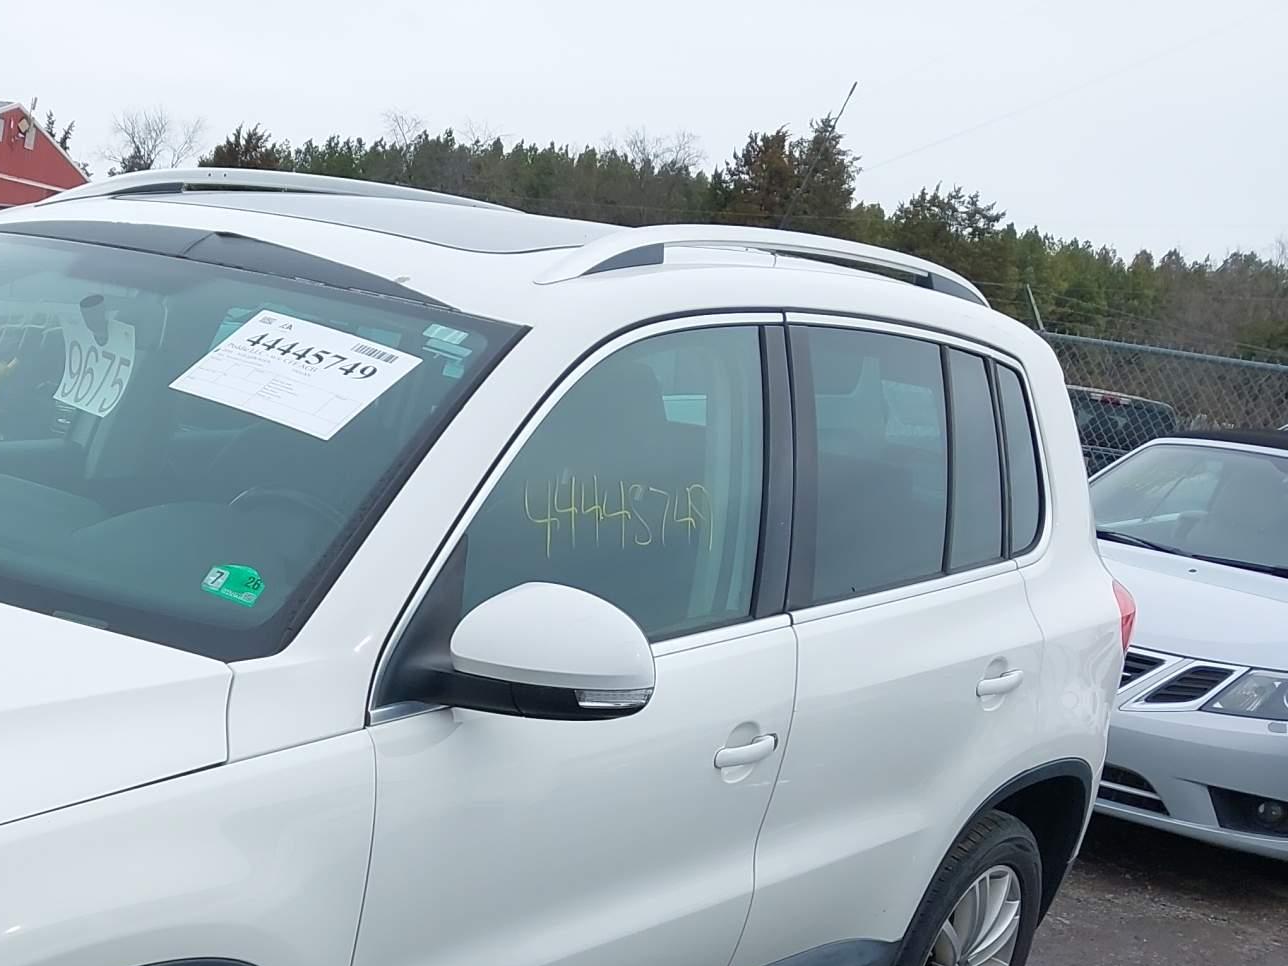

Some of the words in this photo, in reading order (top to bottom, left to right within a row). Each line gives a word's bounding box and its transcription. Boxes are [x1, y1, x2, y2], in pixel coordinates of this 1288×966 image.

[246, 332, 378, 381] 44445749
[61, 340, 132, 413] 9675
[210, 570, 225, 585] 7
[245, 576, 263, 591] 26
